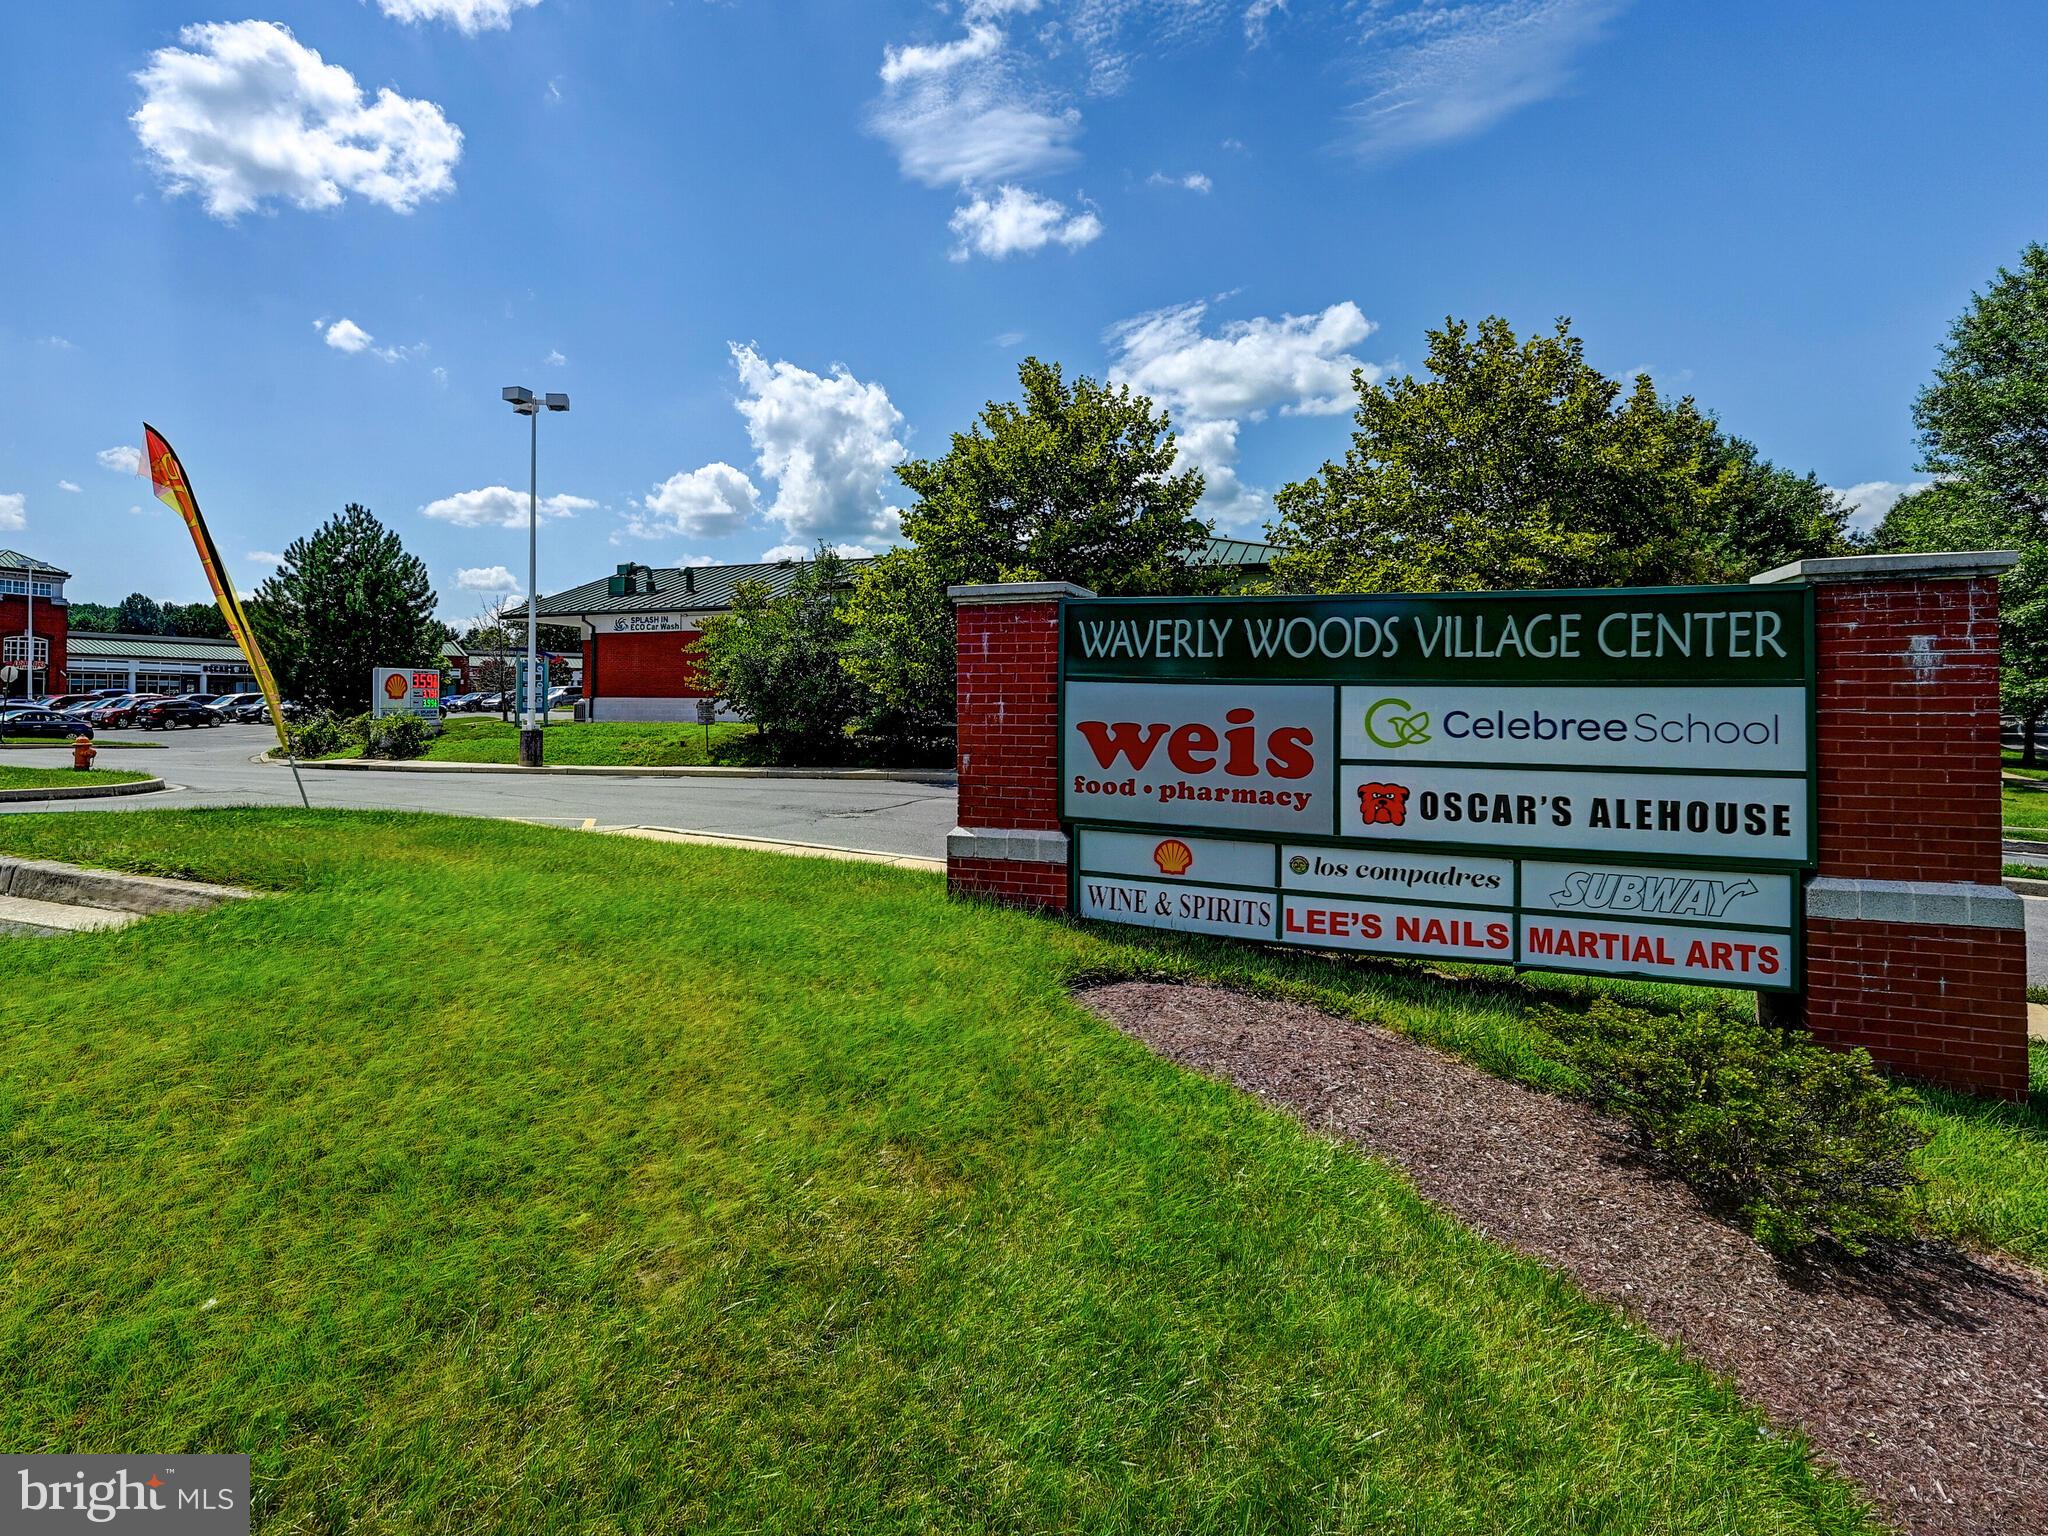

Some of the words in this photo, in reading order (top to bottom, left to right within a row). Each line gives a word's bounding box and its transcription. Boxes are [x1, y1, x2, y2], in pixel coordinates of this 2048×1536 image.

[630, 616, 659, 624] SPLASH
[661, 615, 669, 623] IN
[630, 623, 645, 631] ECO
[646, 623, 659, 631] Car
[660, 622, 680, 631] Wash
[1078, 618, 1233, 660] WAVERLY
[1244, 616, 1400, 660] WOODS
[1415, 613, 1582, 659] VILLAGE
[1597, 610, 1787, 659] CENTER
[1075, 707, 1316, 780] weis
[1442, 709, 1628, 742] Celebree
[1633, 712, 1780, 746] School
[1073, 775, 1137, 797] food
[1158, 780, 1313, 812] pharmacy
[1419, 790, 1573, 828] OSCAR'S
[1588, 796, 1792, 838] ALEHOUSE
[1313, 856, 1349, 878] los
[1355, 865, 1501, 890] compadres
[1549, 869, 1759, 918] SUBWAY
[1087, 884, 1148, 916] WINE
[1154, 892, 1173, 917] &
[1179, 893, 1272, 928] SPIRITS
[1285, 907, 1383, 940] LEE'S
[1396, 916, 1511, 952] NAILS
[1528, 926, 1676, 966] MARTIAL
[1685, 938, 1780, 976] ARTS
